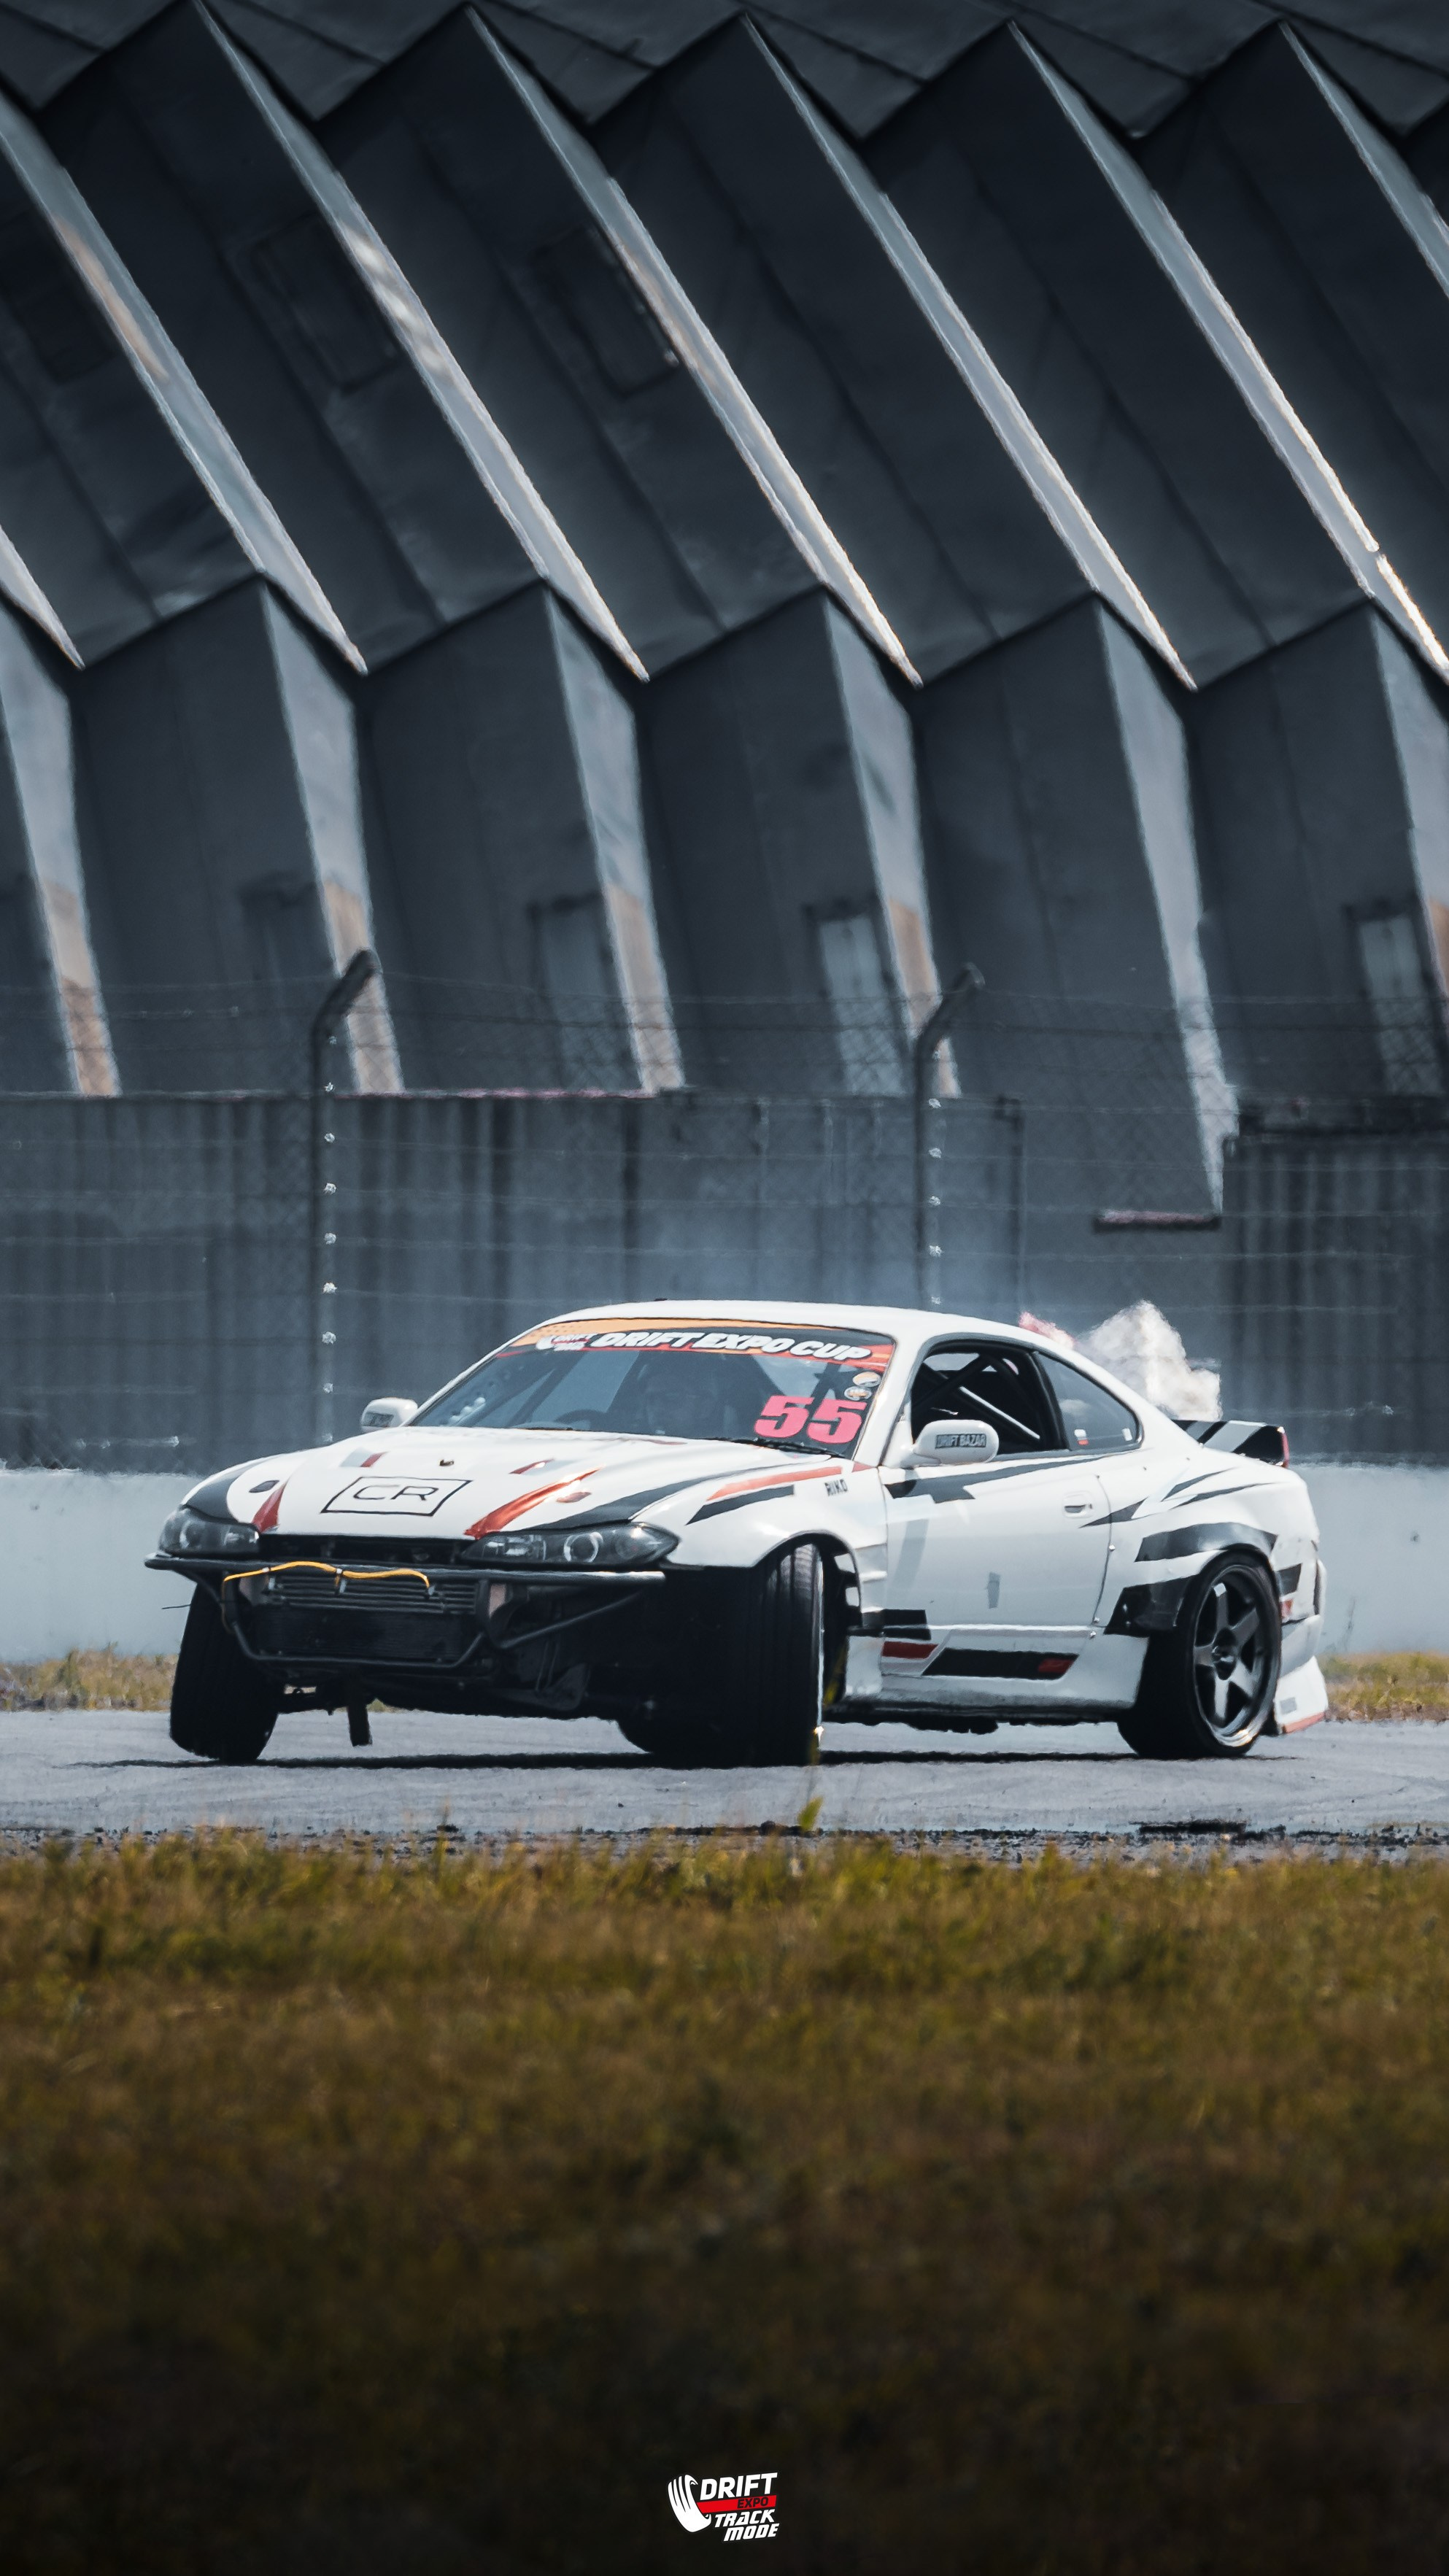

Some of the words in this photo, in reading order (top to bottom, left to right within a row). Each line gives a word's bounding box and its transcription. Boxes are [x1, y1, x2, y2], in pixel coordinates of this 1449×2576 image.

[590, 1331, 706, 1347] DRIFT
[692, 1333, 795, 1353] EXPO
[789, 1340, 872, 1361] CUP
[754, 1395, 868, 1444] 55
[353, 1485, 439, 1501] CR
